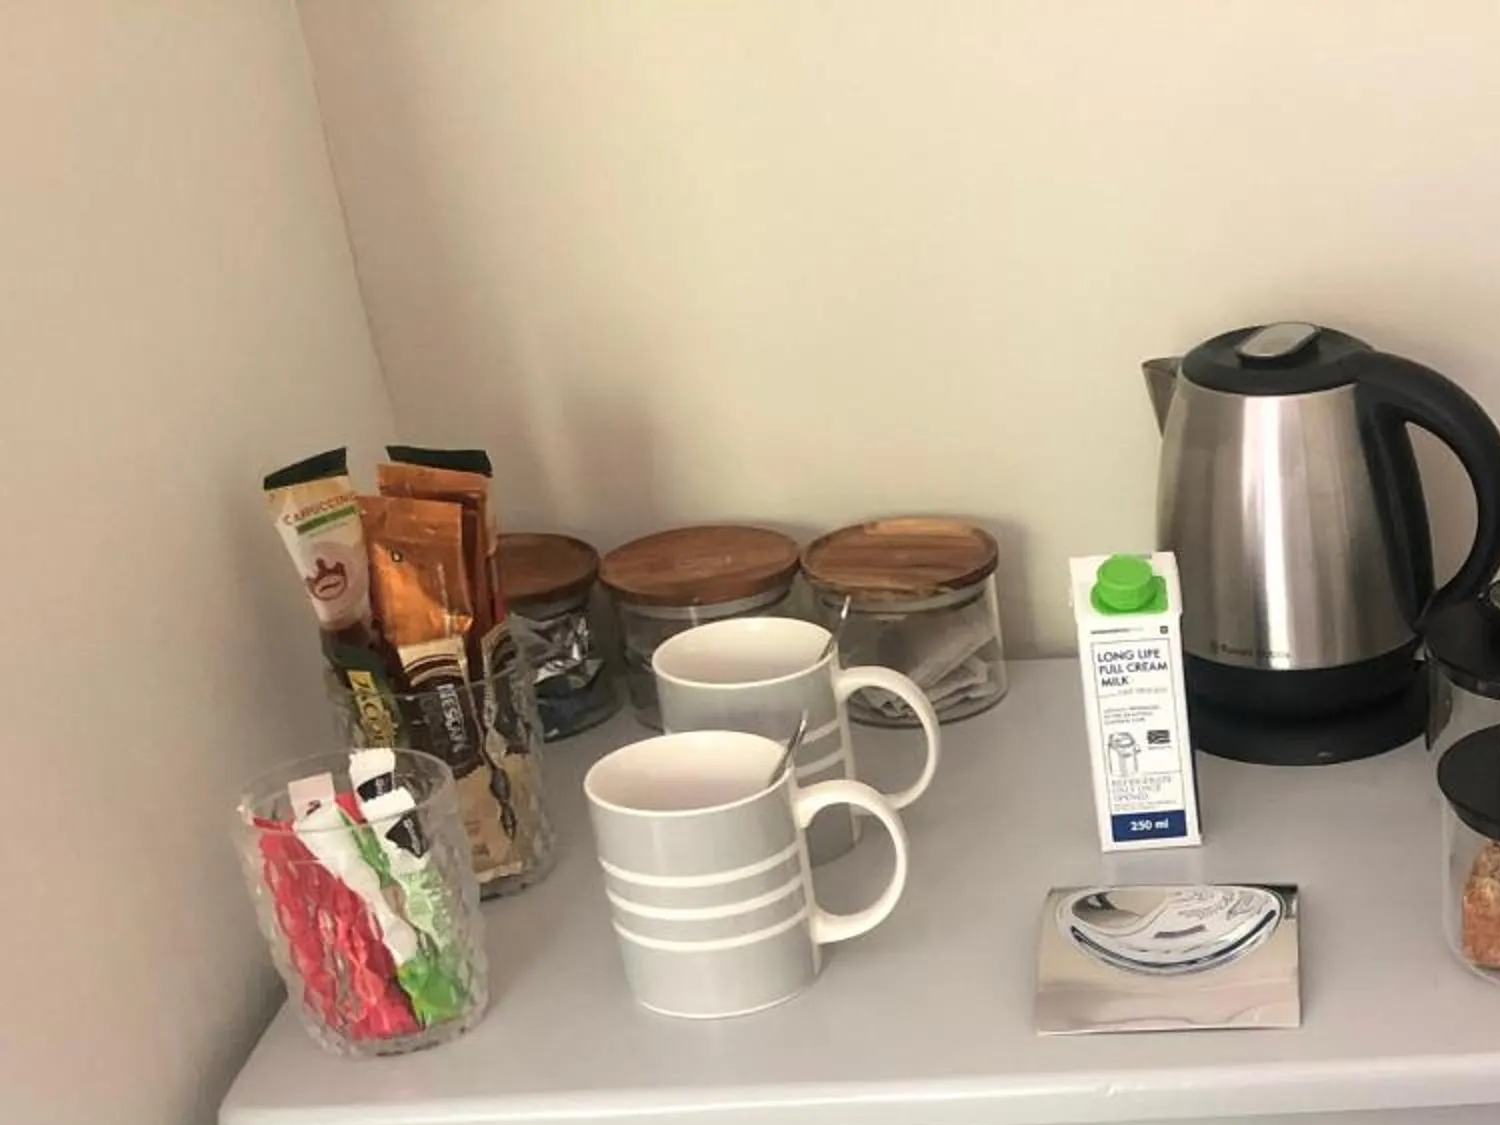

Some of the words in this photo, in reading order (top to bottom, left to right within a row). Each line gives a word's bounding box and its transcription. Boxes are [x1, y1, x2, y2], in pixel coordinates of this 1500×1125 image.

[1097, 649, 1135, 663] LONG
[1137, 647, 1161, 660] LIFE
[1098, 663, 1124, 675] FULL
[1126, 661, 1168, 673] CREAM
[1101, 675, 1129, 688] MILK
[1129, 818, 1153, 832] 250
[1154, 816, 1169, 830] ml
